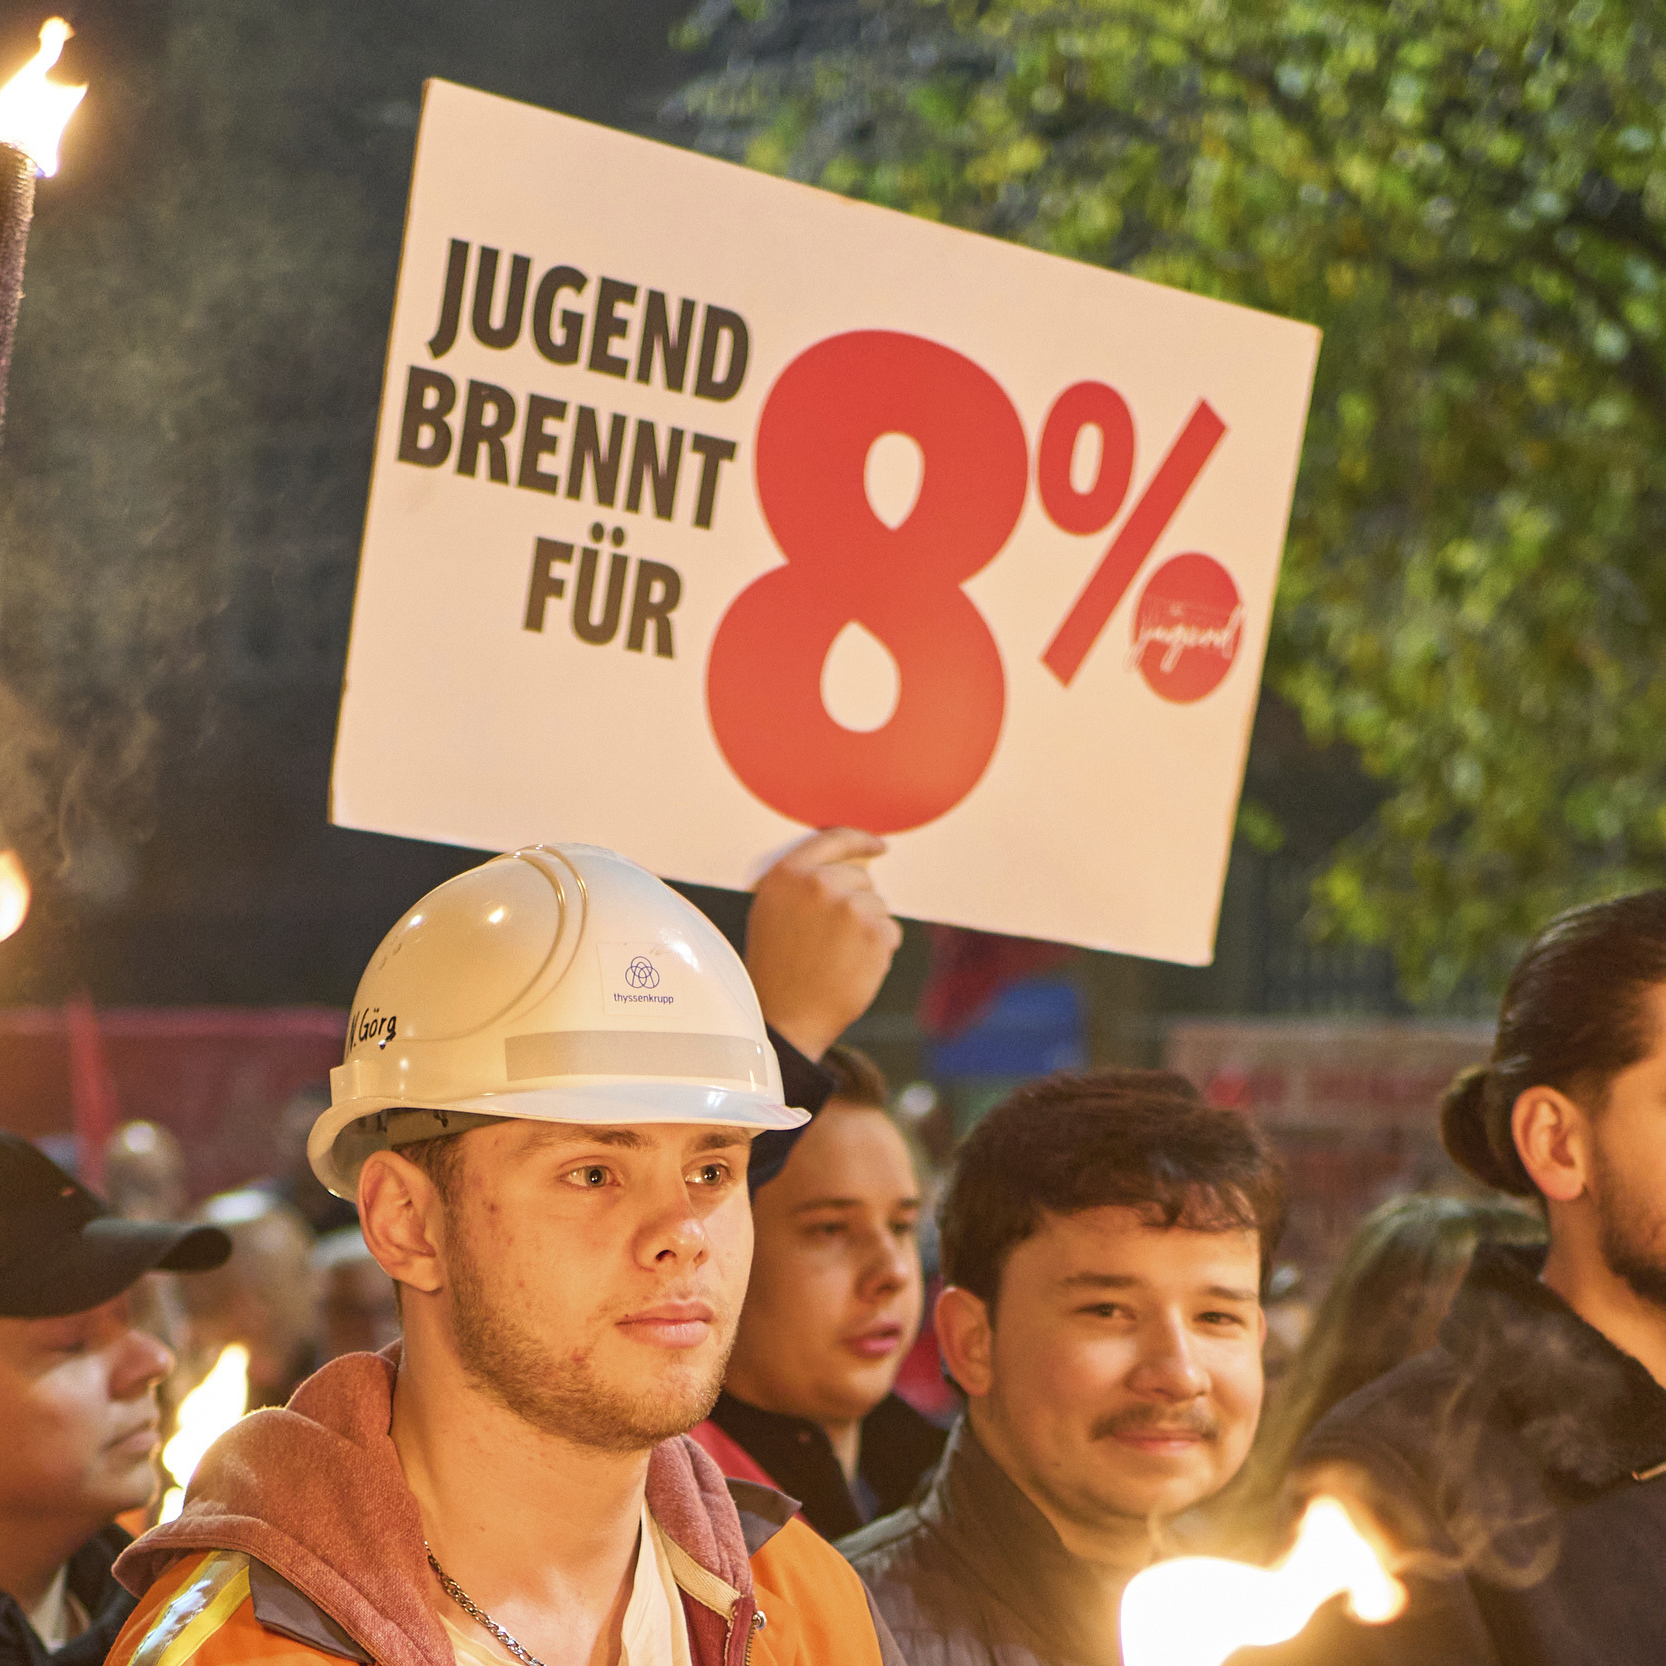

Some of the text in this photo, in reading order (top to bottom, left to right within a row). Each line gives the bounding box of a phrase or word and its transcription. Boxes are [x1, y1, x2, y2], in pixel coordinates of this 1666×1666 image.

[425, 237, 751, 402] JUGEND
[396, 364, 737, 529] BRENNT
[522, 521, 683, 660] FÜR
[704, 328, 1243, 835] 8%
[613, 993, 674, 1005] thyssenkrupp
